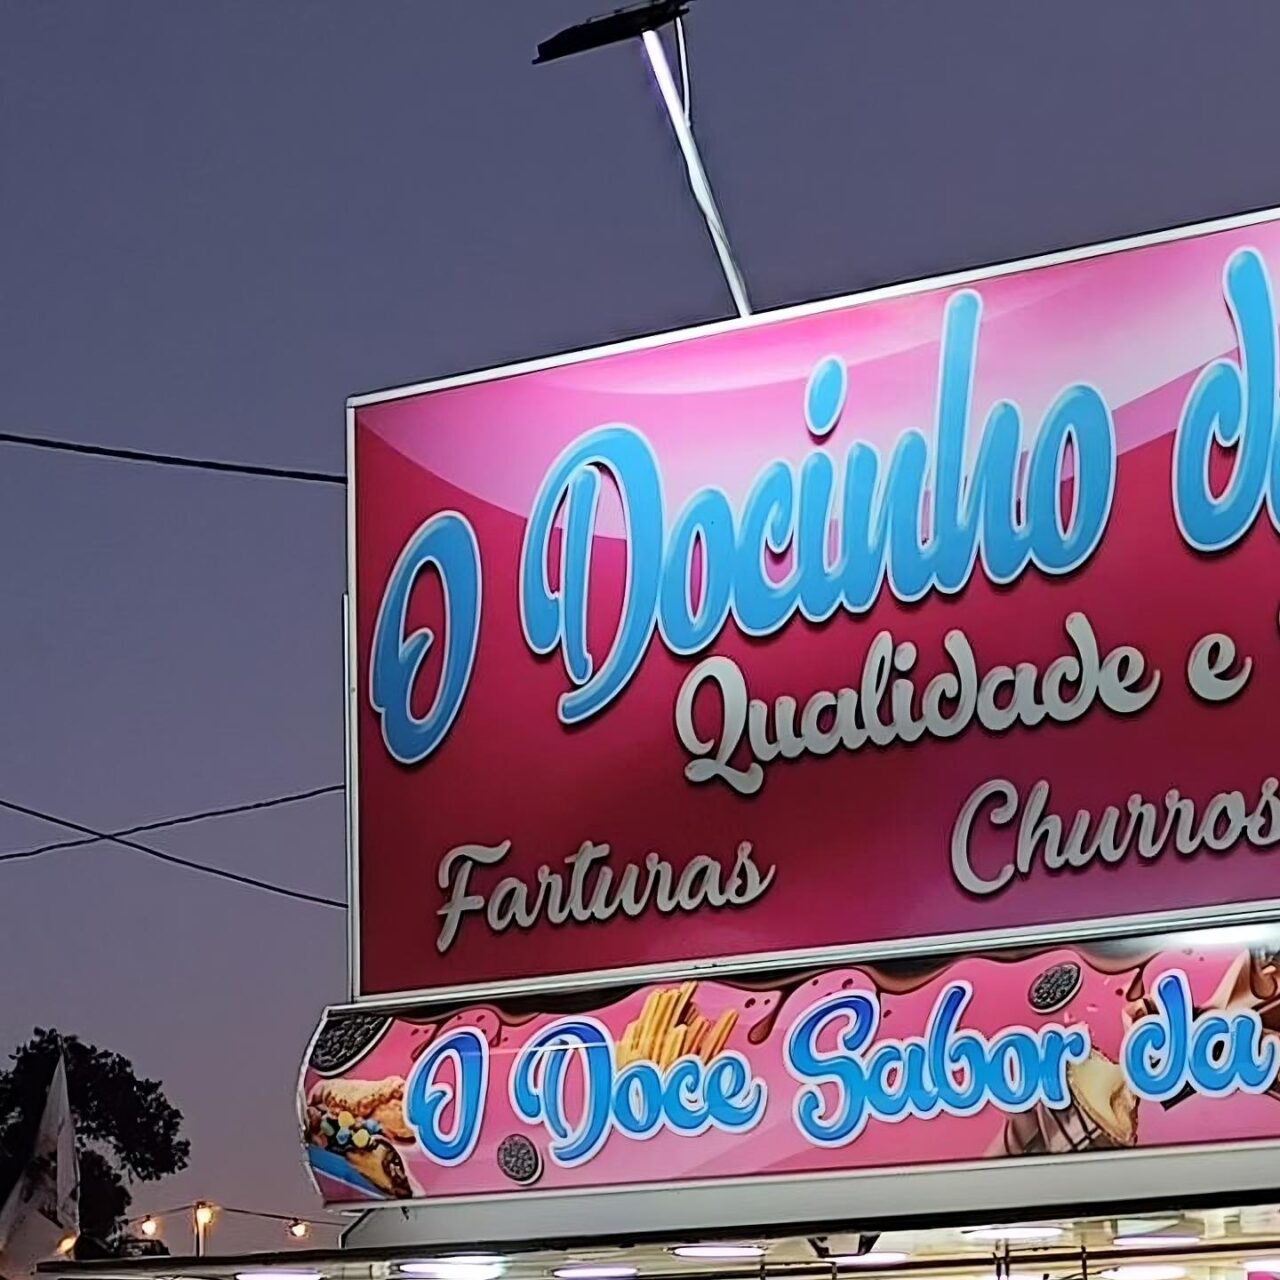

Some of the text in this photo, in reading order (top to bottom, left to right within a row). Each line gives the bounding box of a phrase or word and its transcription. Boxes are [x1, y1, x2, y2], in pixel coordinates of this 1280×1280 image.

[370, 511, 482, 763] O
[519, 288, 1116, 724] Docinho
[675, 611, 1161, 794] Qualidade
[1187, 632, 1251, 701] e
[436, 839, 775, 954] Farturas
[407, 1025, 490, 1169] O
[511, 1016, 767, 1167] Doce
[786, 979, 1092, 1147] Sabor
[1120, 969, 1280, 1101] da
